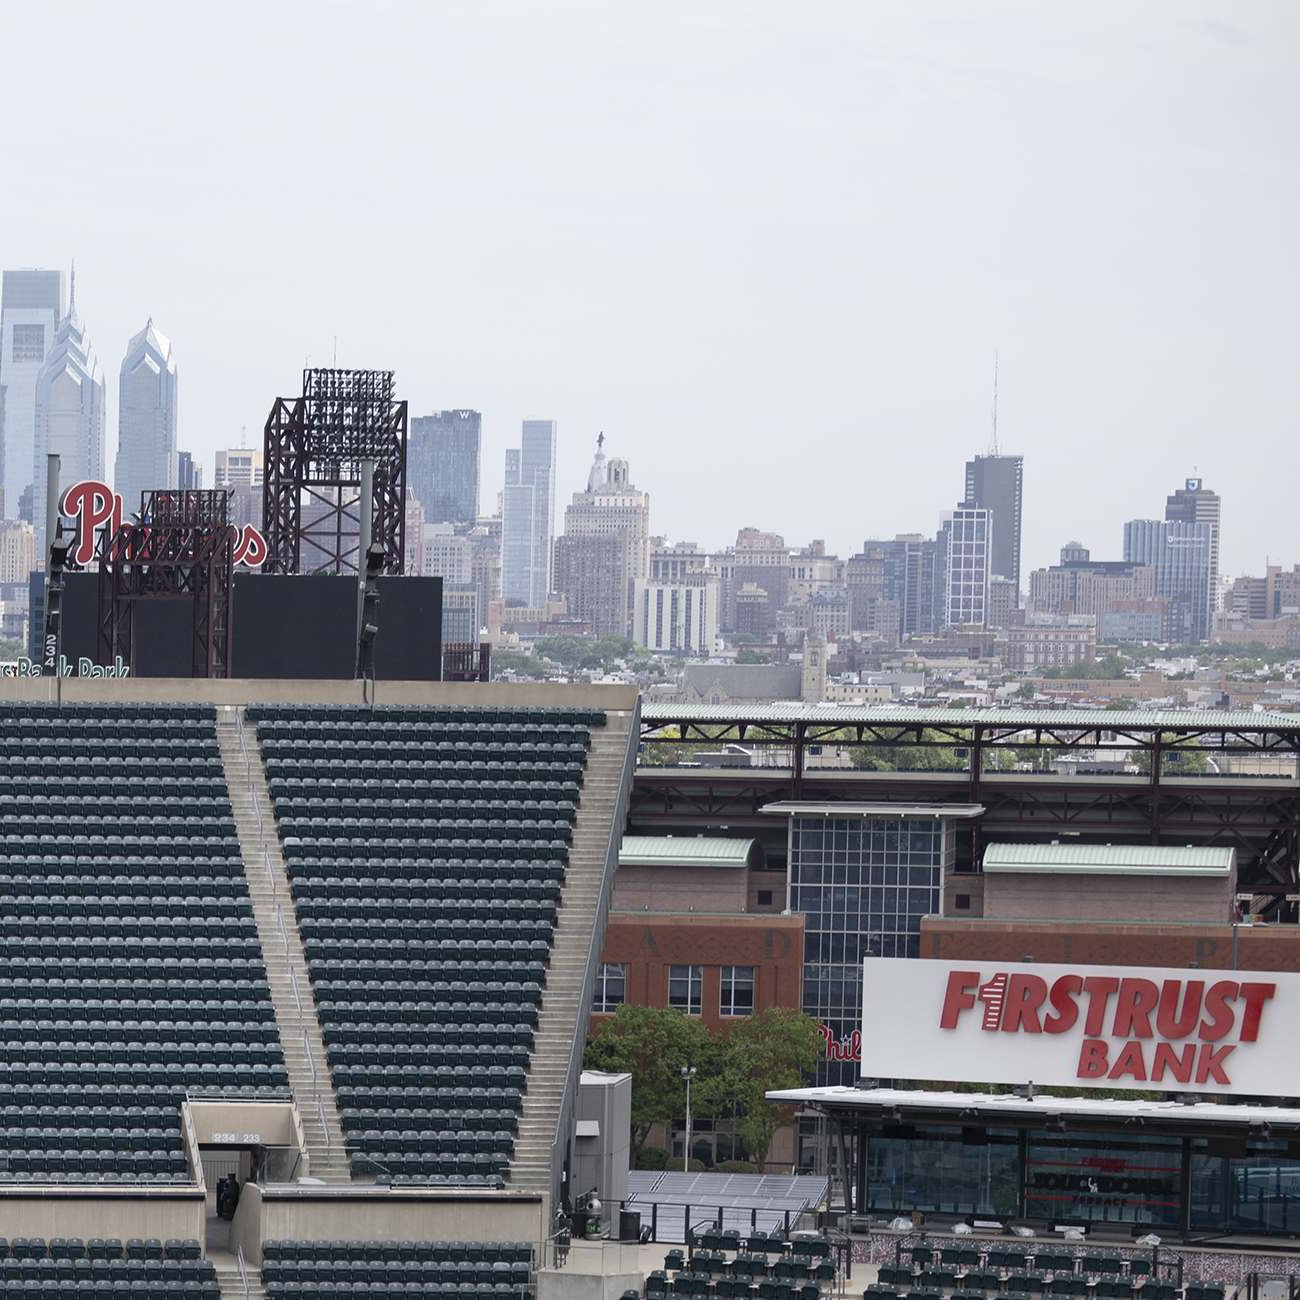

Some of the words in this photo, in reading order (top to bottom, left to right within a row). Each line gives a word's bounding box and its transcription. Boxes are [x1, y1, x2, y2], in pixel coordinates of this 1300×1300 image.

[459, 411, 470, 419] W
[44, 634, 57, 668] 234
[17, 656, 74, 677] Bak
[1076, 1039, 1238, 1085] BANK
[214, 1133, 236, 1143] 234
[243, 1134, 260, 1143] 233
